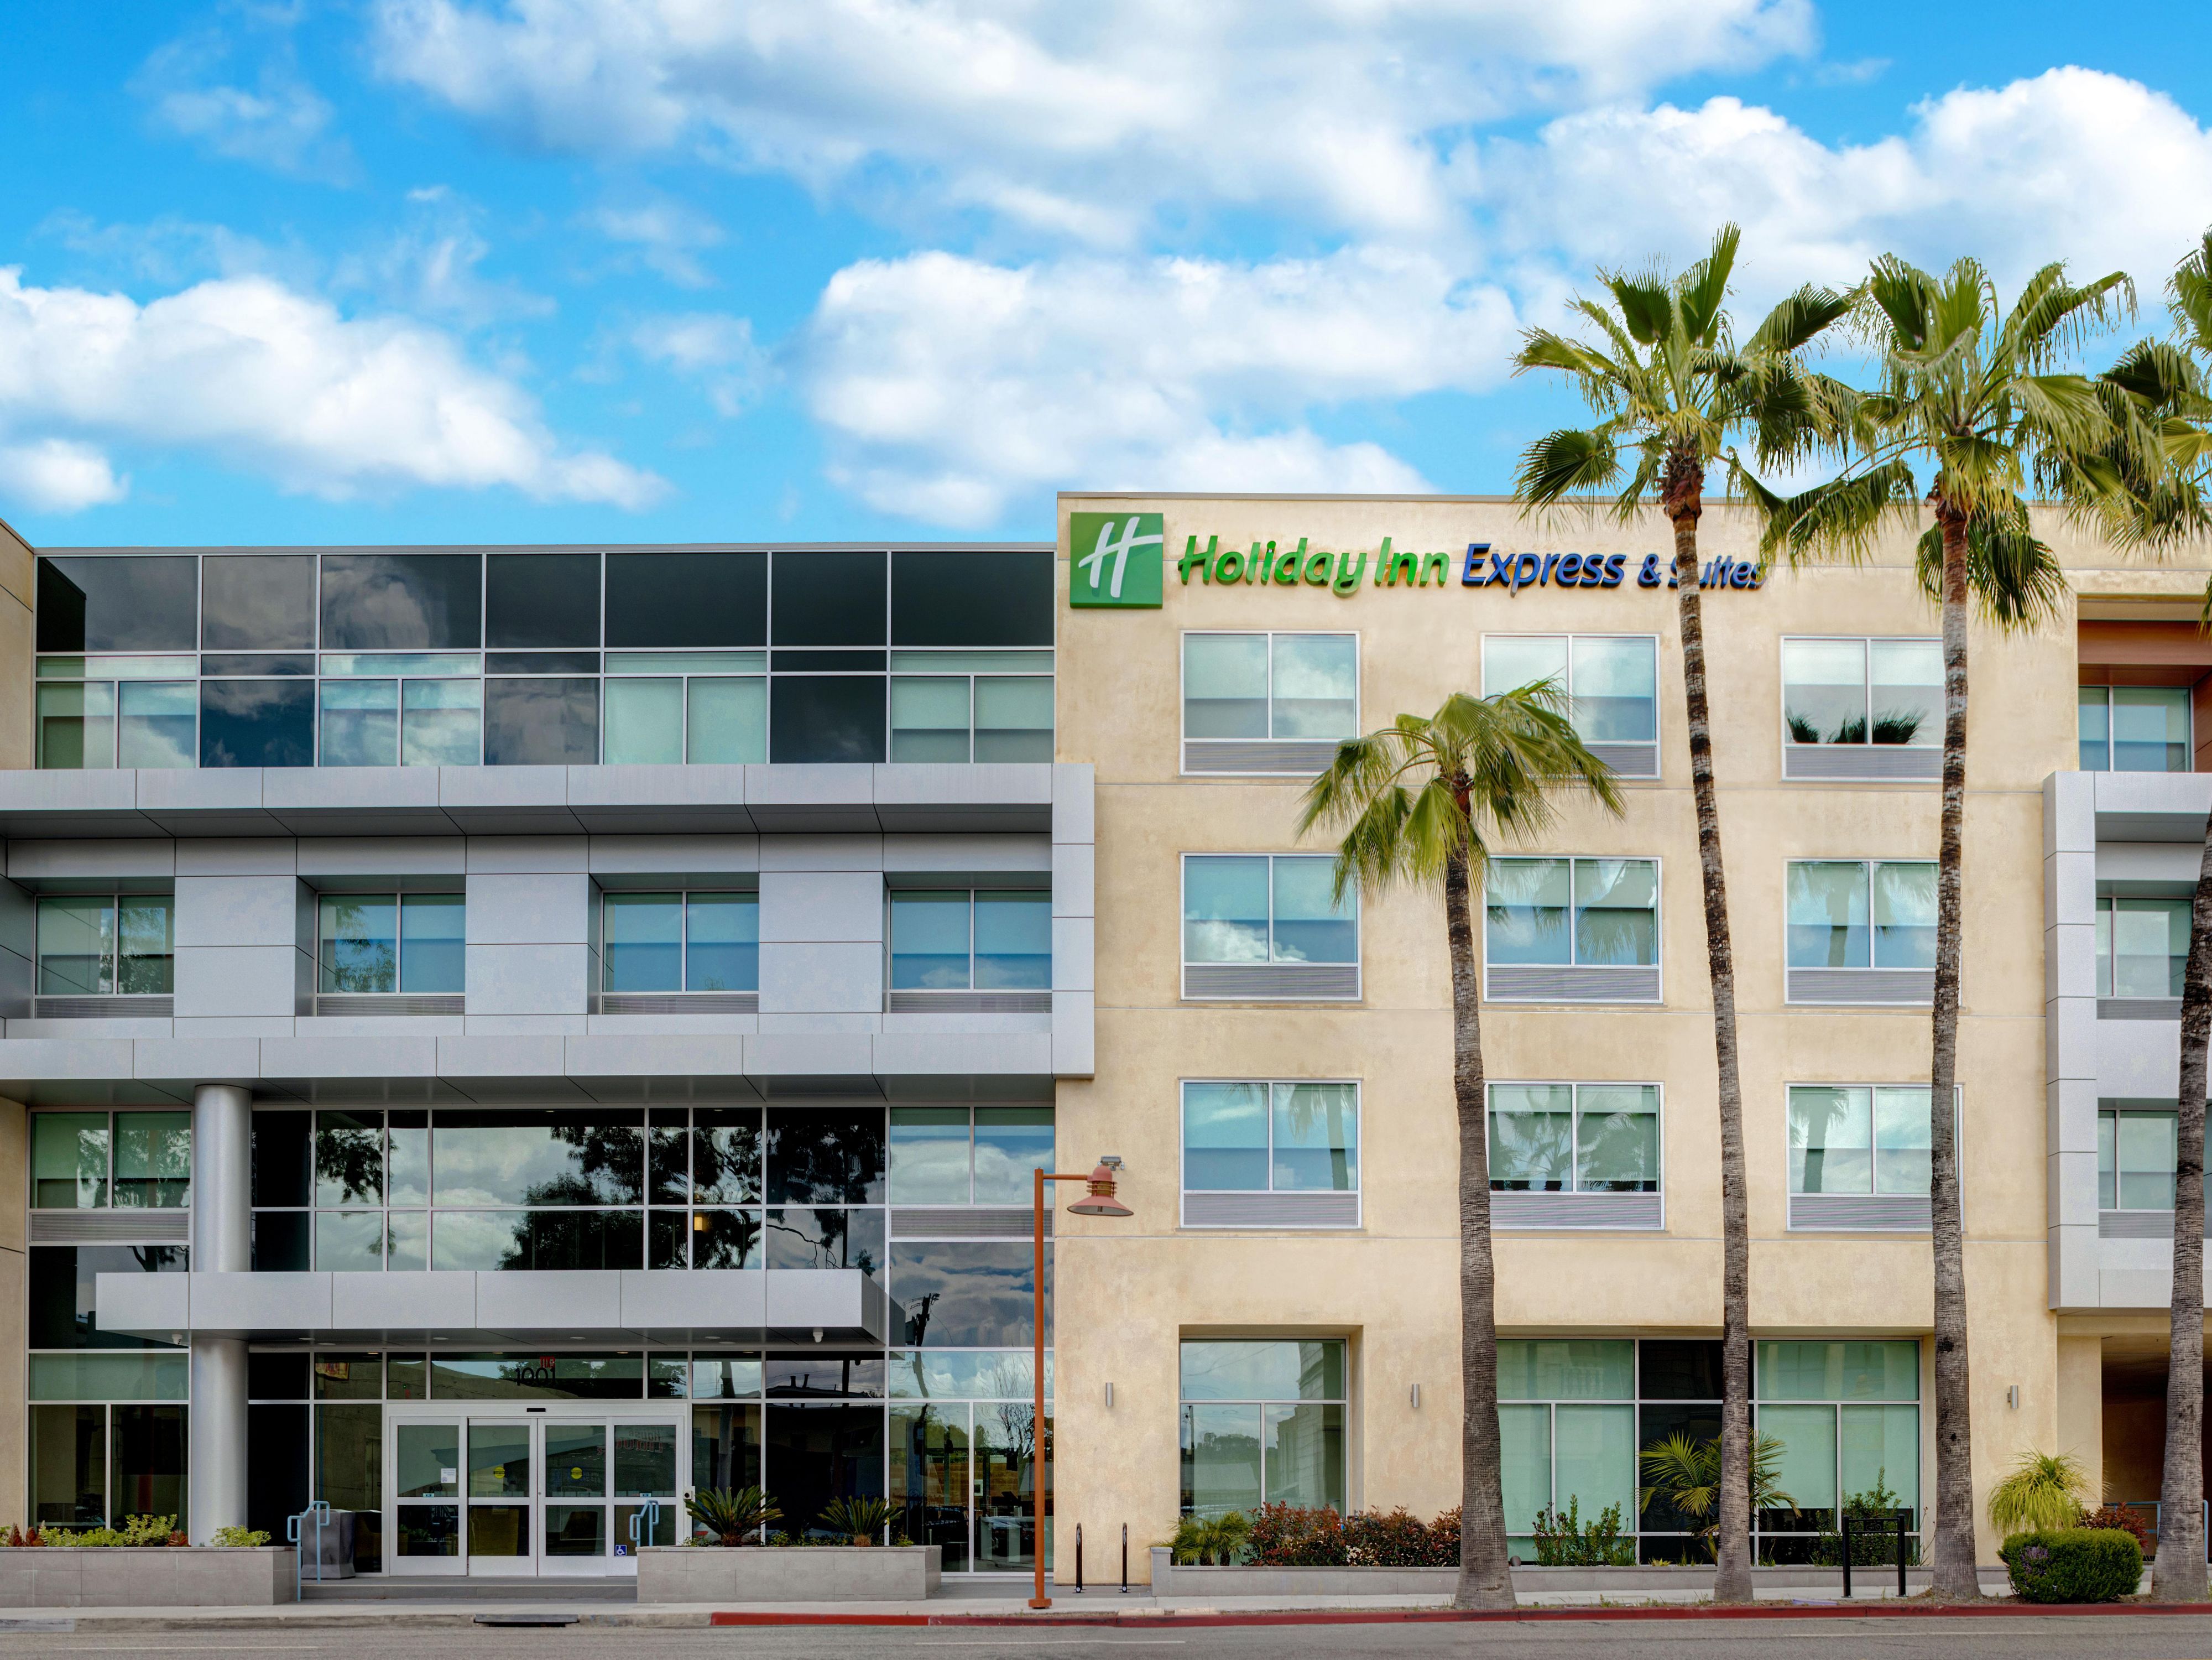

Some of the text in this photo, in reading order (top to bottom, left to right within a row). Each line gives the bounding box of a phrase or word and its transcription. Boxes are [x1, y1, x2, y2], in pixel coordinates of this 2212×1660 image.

[1177, 535, 1367, 599] Holiday
[1374, 537, 1450, 587] Inn
[1461, 543, 1627, 597] Express
[1637, 553, 1661, 587] &
[515, 1367, 556, 1386] 1001
